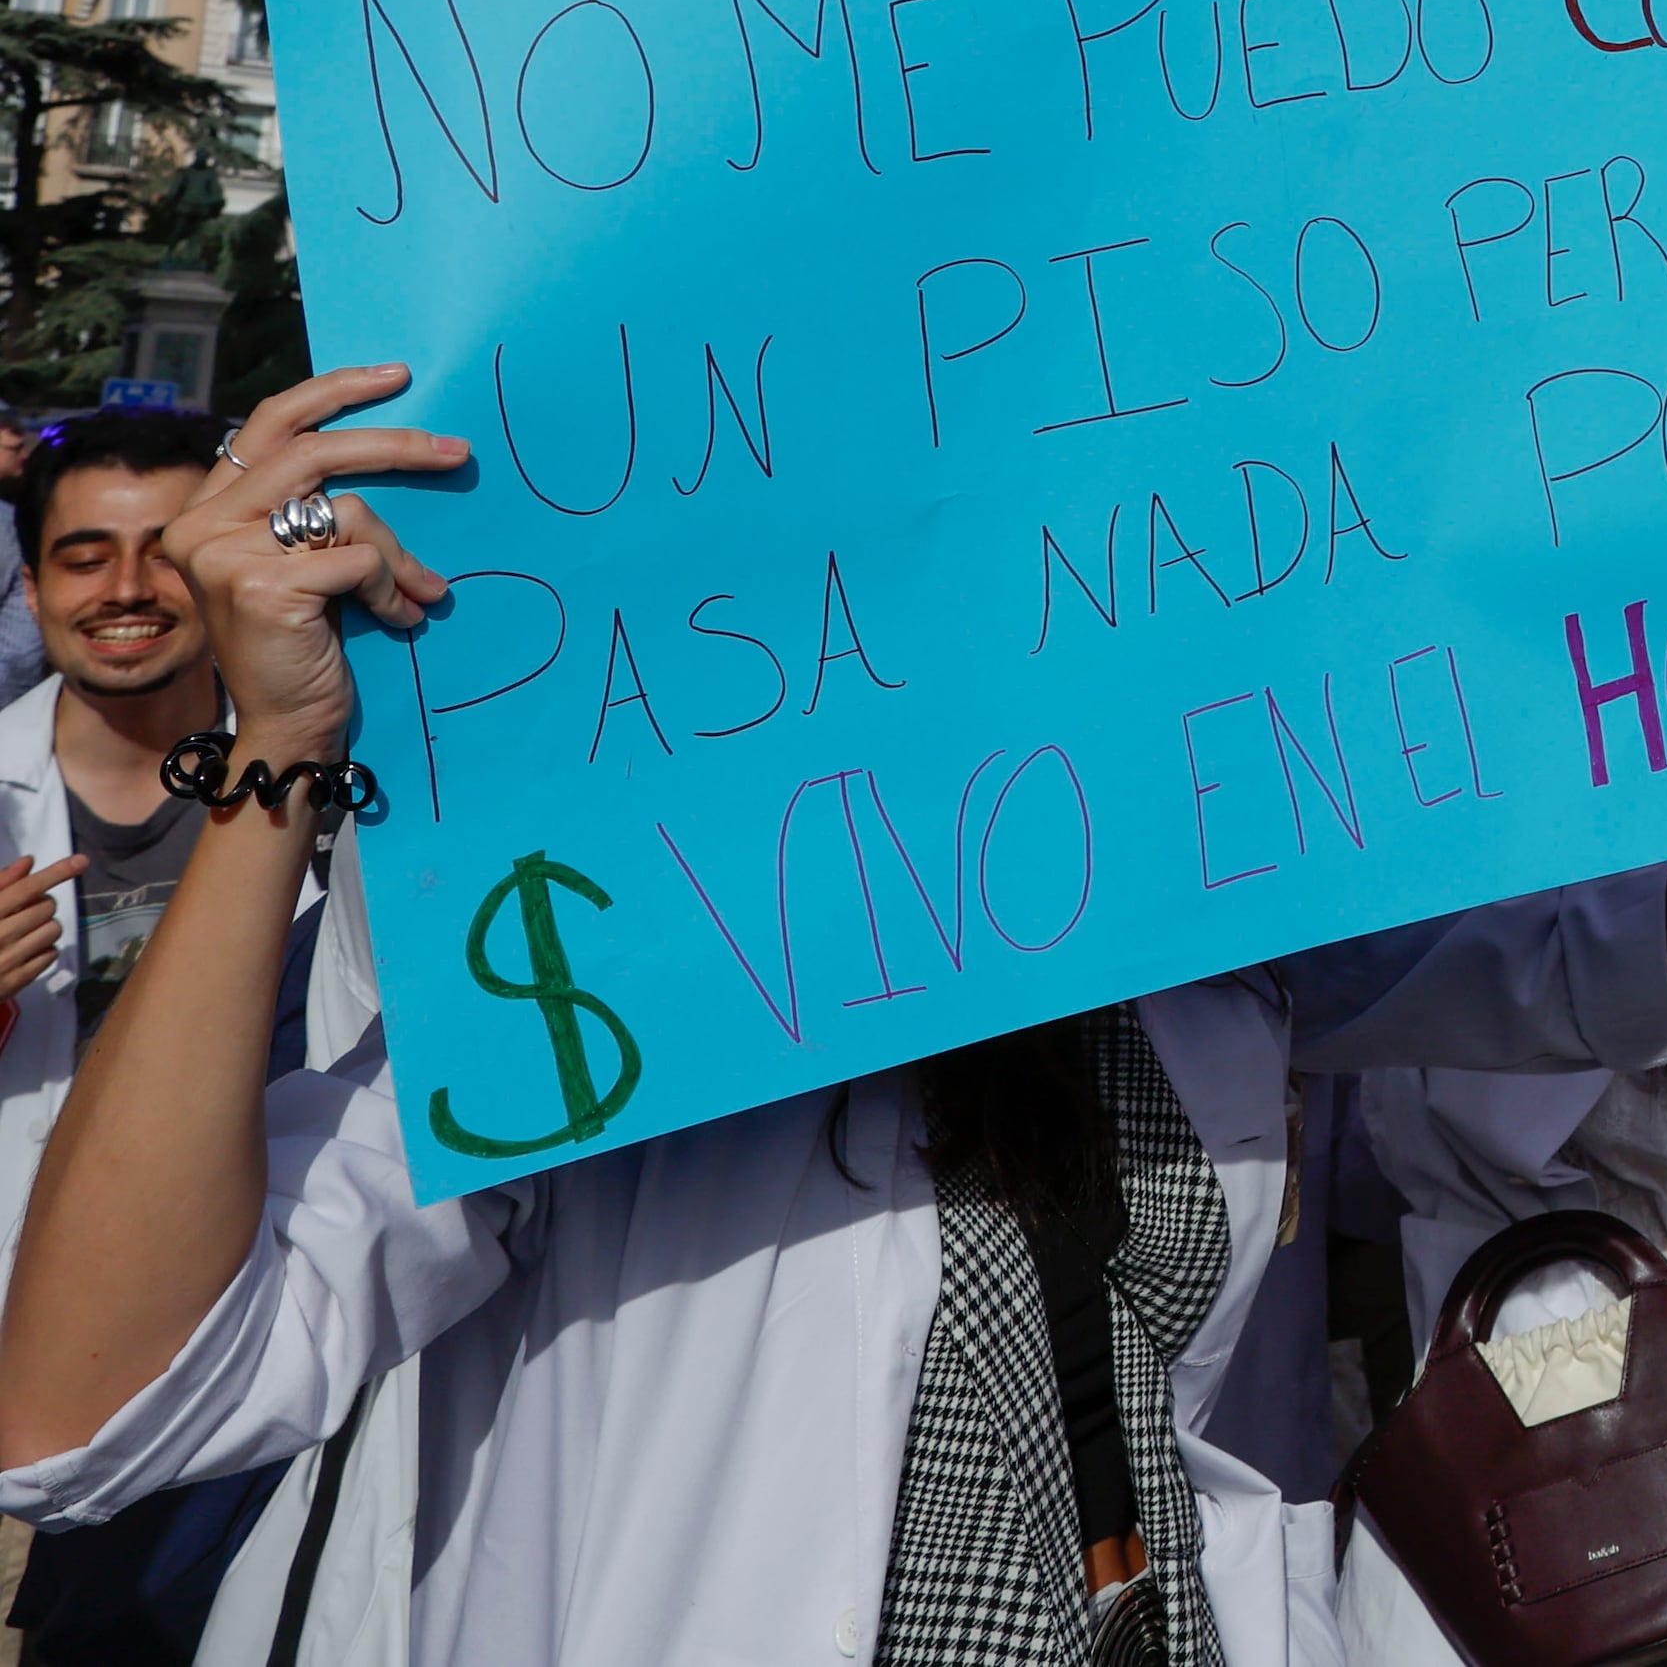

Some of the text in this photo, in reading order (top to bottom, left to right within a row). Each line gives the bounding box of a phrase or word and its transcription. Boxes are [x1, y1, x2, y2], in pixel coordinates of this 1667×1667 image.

[494, 323, 774, 516] UN
[916, 216, 1381, 449] PISO
[403, 550, 908, 824] PASA
[1029, 440, 1409, 658] NADA
[656, 744, 1093, 1045] VIVO
[1182, 673, 1364, 889] EN
[1388, 645, 1504, 807] EL
